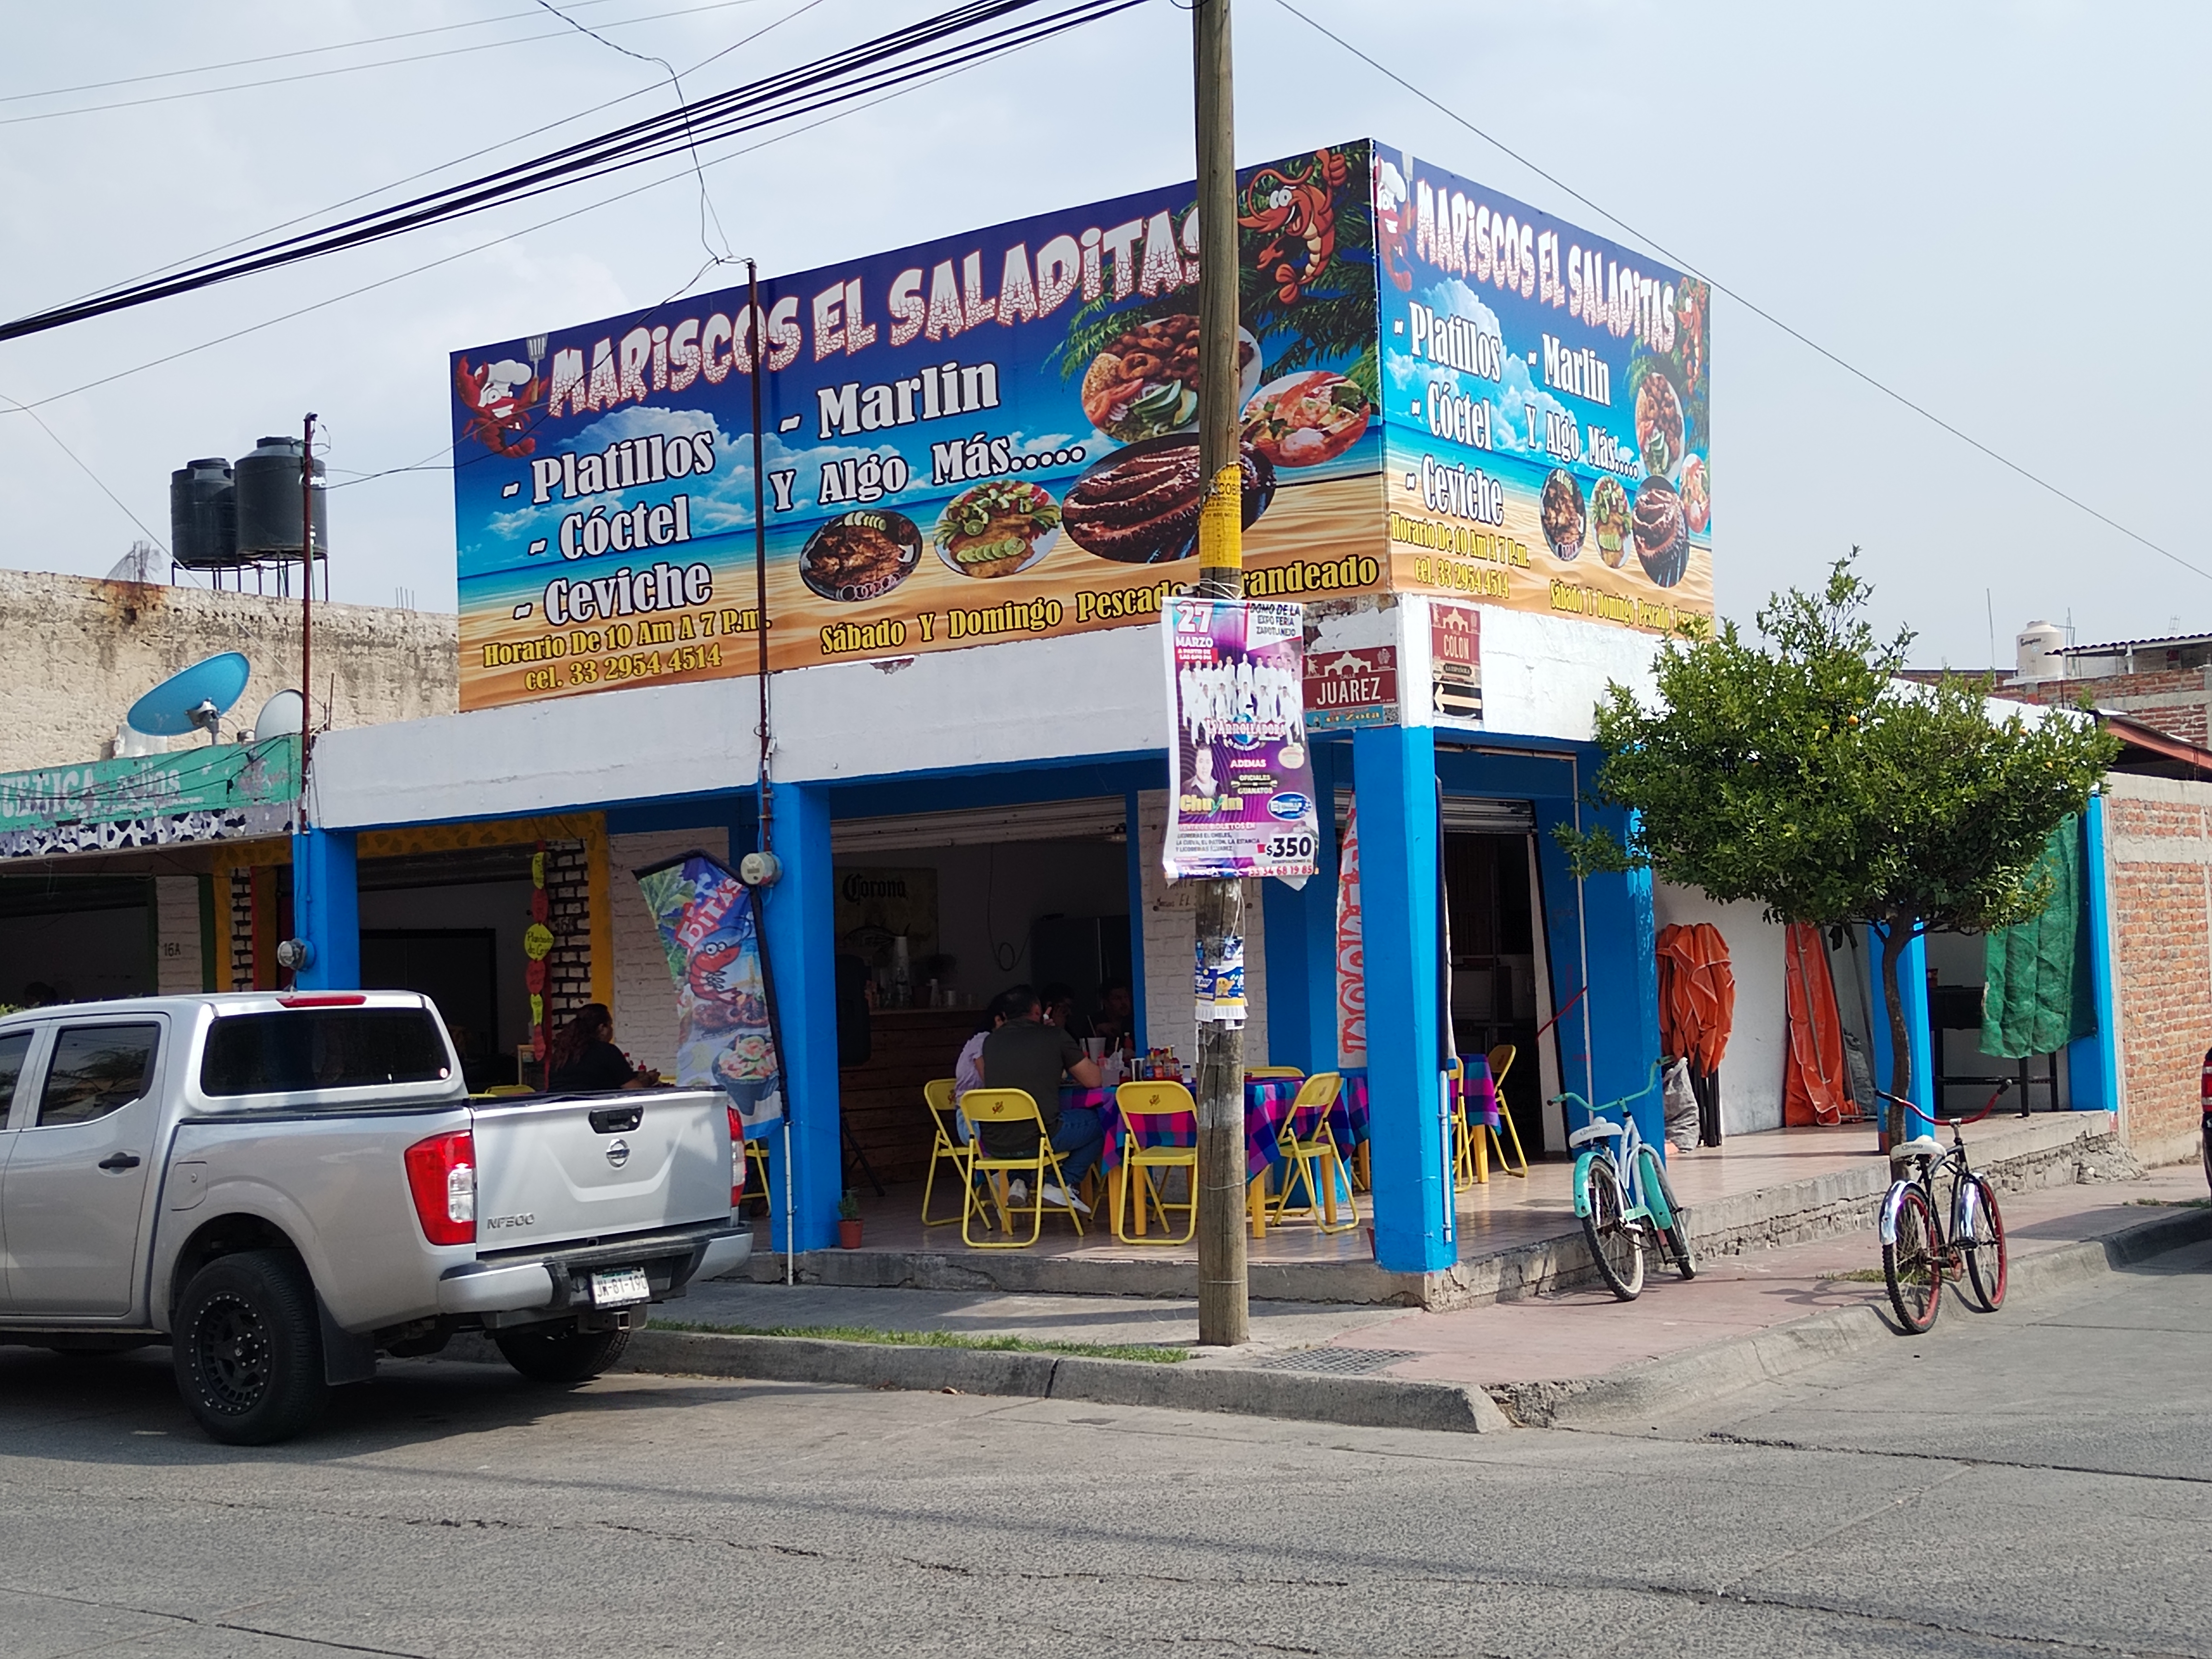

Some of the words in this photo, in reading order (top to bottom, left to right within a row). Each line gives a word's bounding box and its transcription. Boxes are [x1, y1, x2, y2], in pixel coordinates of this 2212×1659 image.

[1538, 228, 1566, 310] EL
[812, 276, 878, 362] EL
[1409, 300, 1503, 384] Platillos
[1541, 333, 1611, 407] Marlin
[816, 359, 999, 442] Marlin
[1427, 380, 1493, 452] Cóctel
[1524, 404, 1538, 448] Y
[1545, 411, 1580, 463] Algo
[531, 431, 714, 505] Platillos
[769, 469, 797, 514] Y
[817, 453, 908, 506] Algo
[1421, 453, 1504, 527] Ceviche
[559, 494, 691, 561] Cóctel
[1390, 511, 1436, 547] Horario
[1436, 521, 1454, 552] De
[1455, 525, 1469, 554] 10
[1470, 528, 1489, 559] Am
[1490, 534, 1498, 561] A
[1498, 536, 1506, 565] 7
[543, 562, 713, 626] Ceviche
[1415, 556, 1436, 585] cel.
[1437, 560, 1454, 585] 33
[1454, 563, 1483, 593] 2954
[1483, 569, 1510, 599] 4514
[1549, 579, 1583, 614] Sábado
[1586, 588, 1595, 615] Y
[1596, 589, 1634, 626] Domingo
[1637, 597, 1671, 629] Pescado
[820, 618, 906, 654] Sábado
[918, 611, 935, 642] Y
[948, 598, 1063, 638] Domingo
[1175, 601, 1214, 634] 27
[1250, 603, 1275, 614] DOMO
[1276, 604, 1288, 615] DE
[1290, 605, 1300, 616] LA
[1275, 616, 1295, 626] FERIA
[483, 635, 566, 668] Horario
[571, 630, 601, 656] De
[606, 625, 633, 650] 10
[637, 619, 675, 647] Am
[679, 615, 702, 641] A
[702, 613, 716, 637] 7
[525, 665, 563, 692] cel.
[569, 662, 599, 686] 33
[604, 651, 661, 681] 2954
[668, 643, 722, 671] 4514
[1176, 636, 1214, 648] MARZO
[1443, 634, 1469, 660] COLON
[1317, 677, 1381, 705] JUAREZ
[1266, 837, 1311, 857] $350
[1276, 866, 1287, 875] 68
[1290, 866, 1299, 875] 19
[1301, 865, 1312, 874] 85
[842, 873, 906, 905] Corona
[164, 943, 181, 957] 16A
